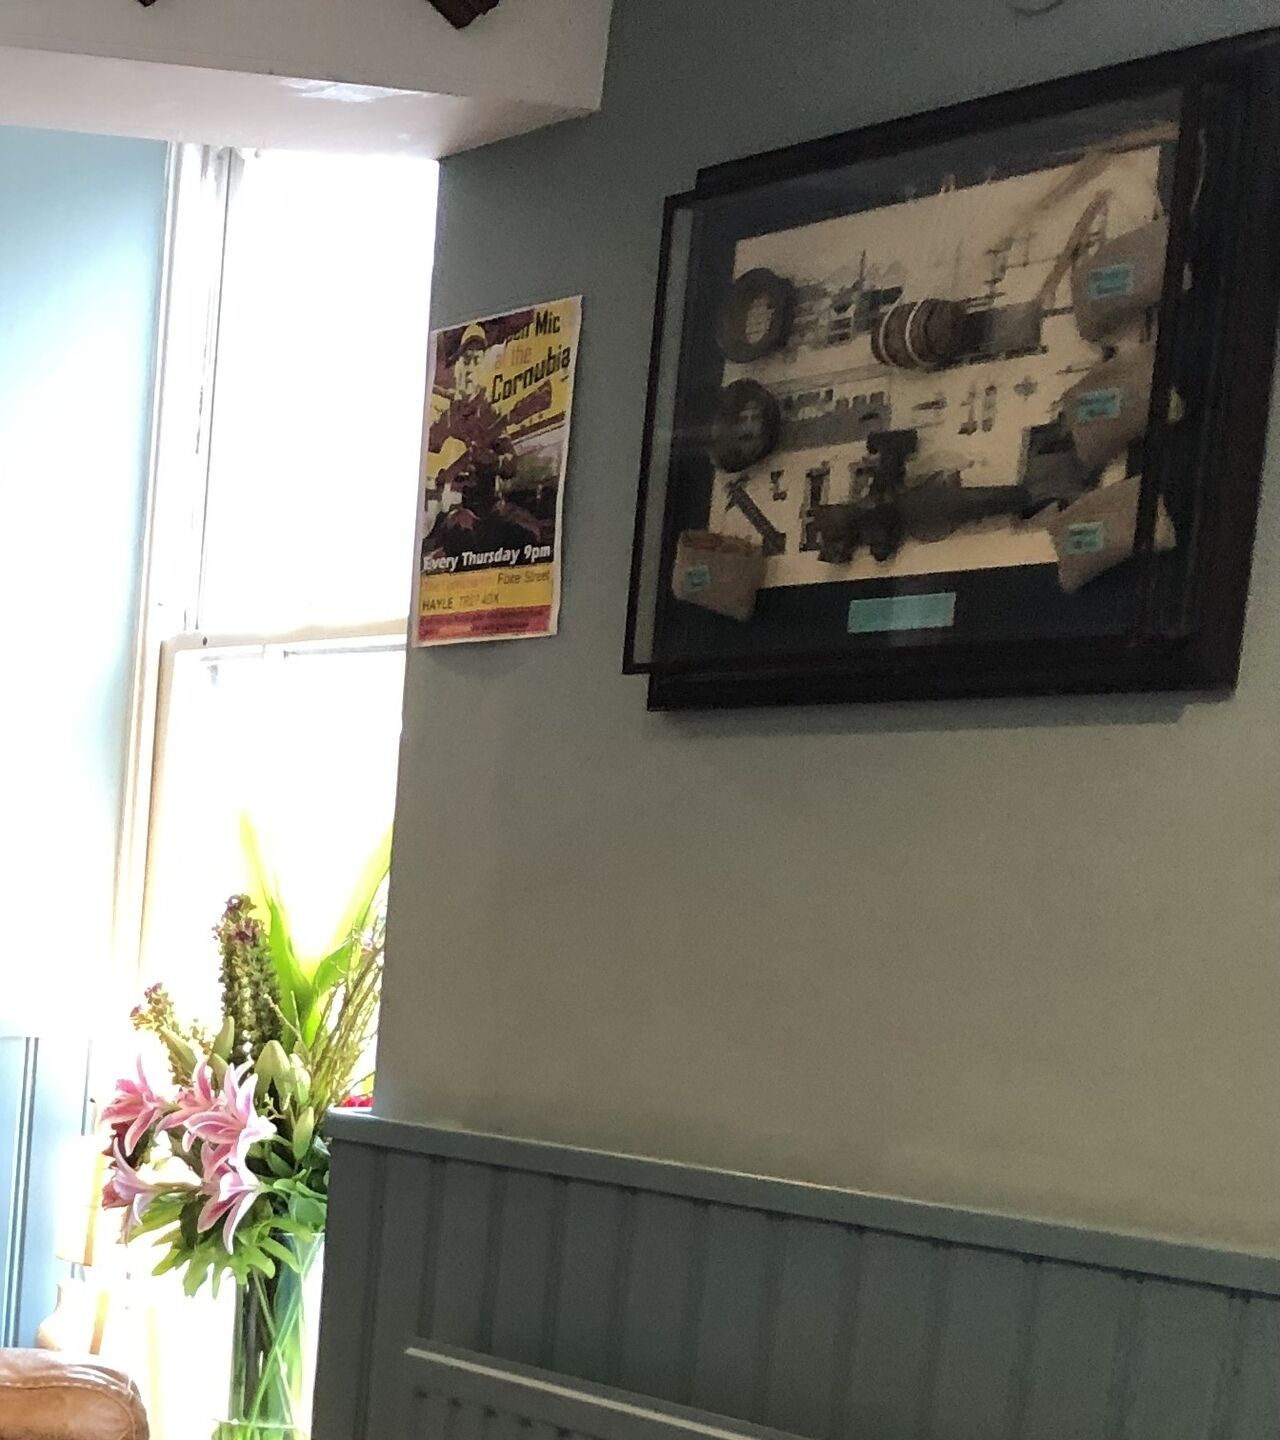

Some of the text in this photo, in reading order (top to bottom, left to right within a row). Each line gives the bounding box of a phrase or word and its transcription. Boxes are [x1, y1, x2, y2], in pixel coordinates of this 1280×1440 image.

[535, 309, 560, 336] Mic
[490, 344, 571, 404] Cornubia
[423, 545, 551, 571] Every Thursday 9pm
[422, 597, 453, 611] HAYLE
